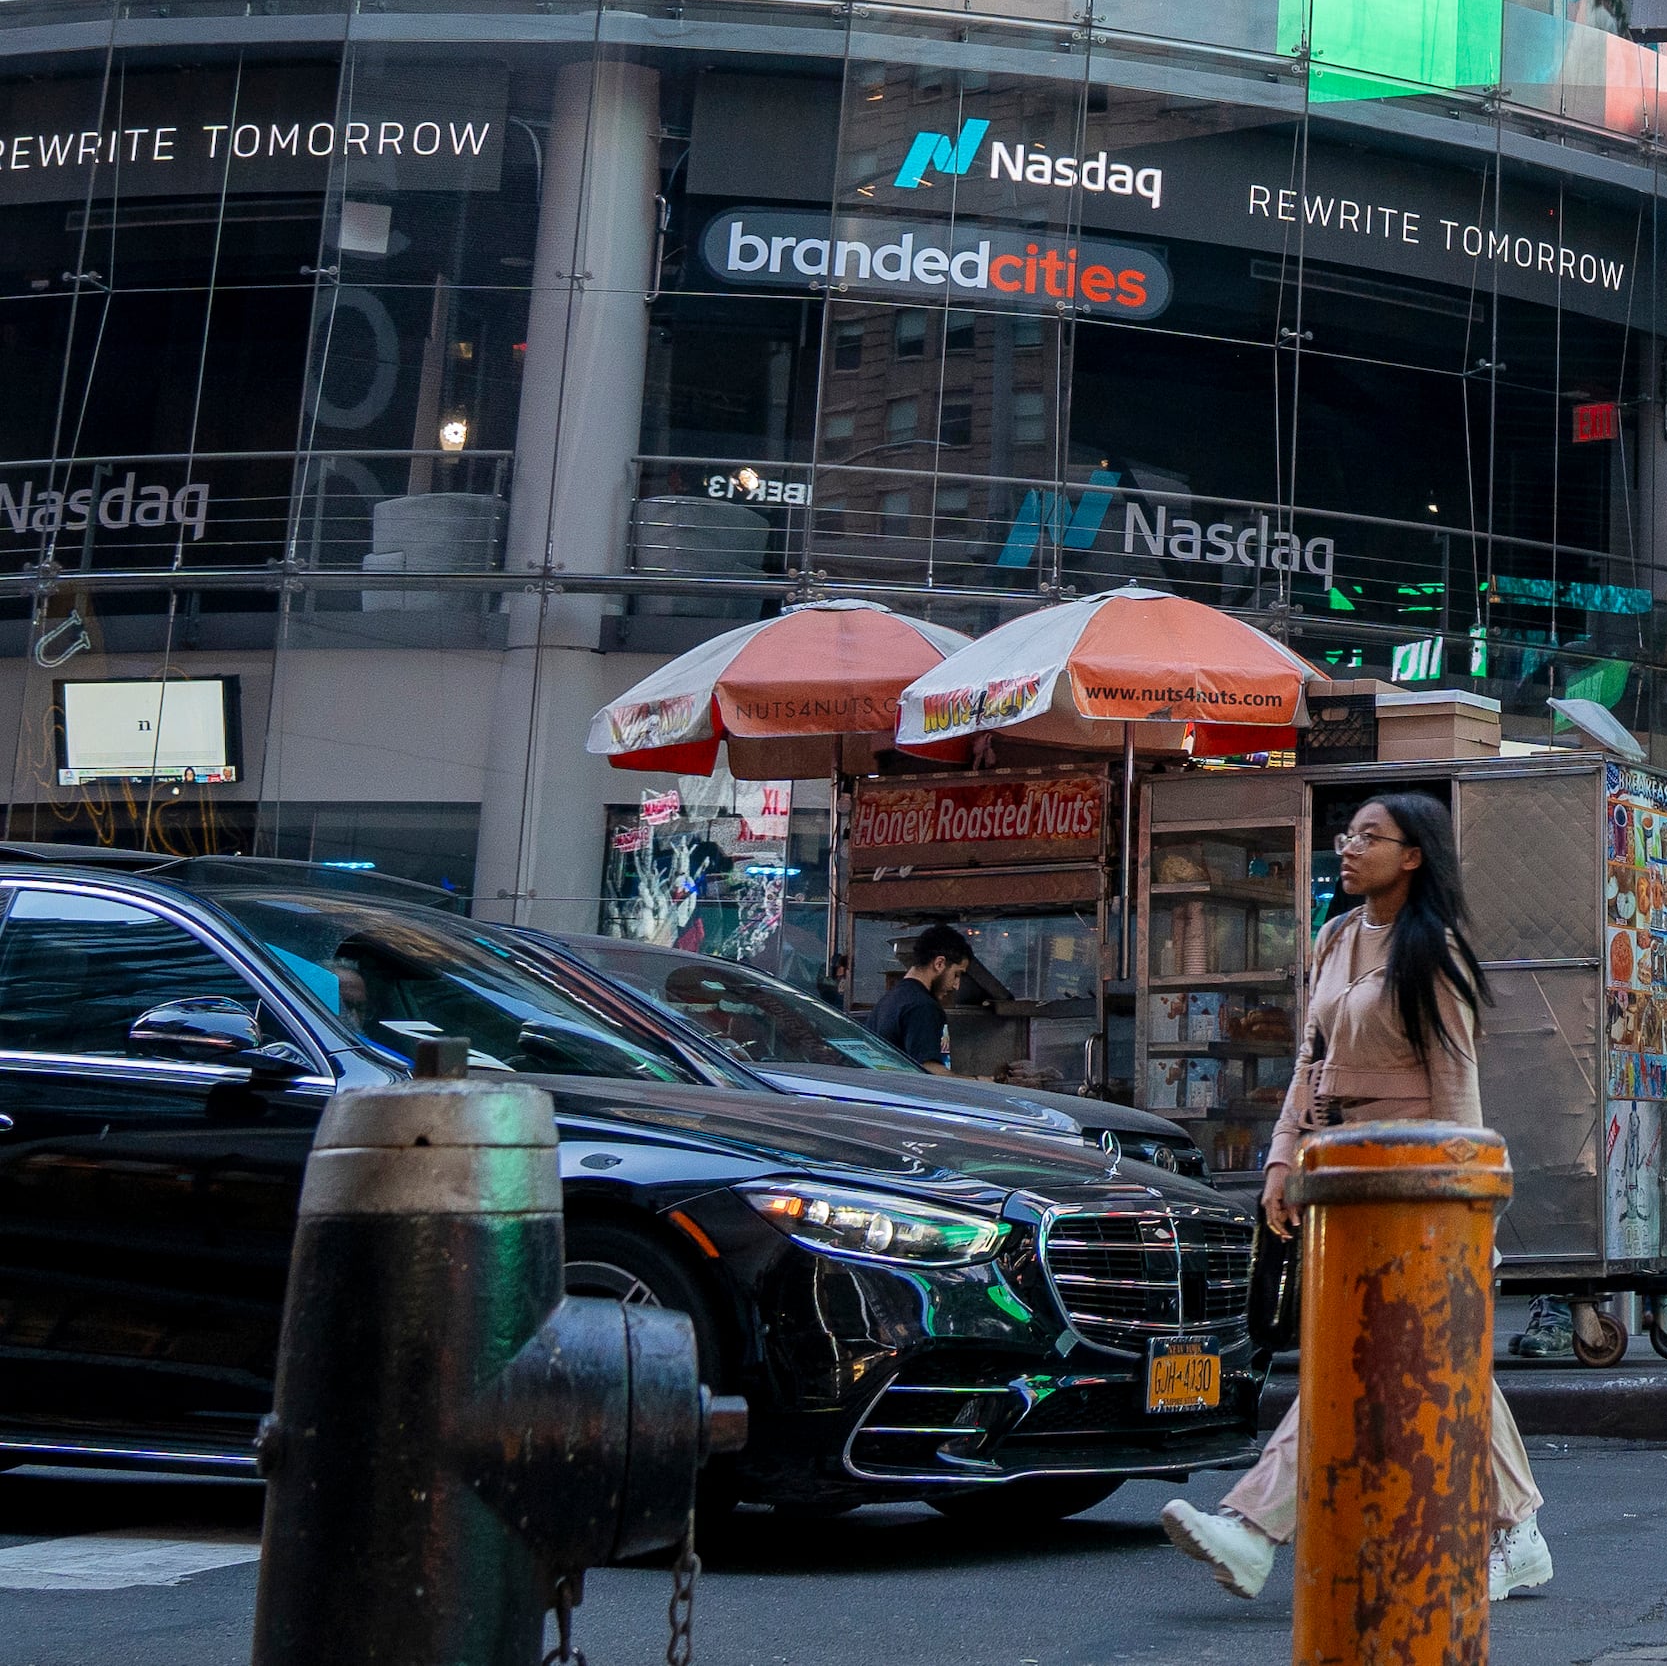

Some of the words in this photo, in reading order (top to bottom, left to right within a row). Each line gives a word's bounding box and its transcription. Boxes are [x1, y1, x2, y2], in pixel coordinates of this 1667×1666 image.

[202, 121, 491, 160] TOMORROW
[990, 140, 1162, 209] Nasdaq
[727, 220, 1148, 308] brandedcities
[1248, 184, 1421, 244] REWRITE
[1440, 219, 1625, 291] TOMORROW
[0, 471, 210, 542] Nasdaq
[1122, 500, 1335, 592] Nasdaq
[736, 696, 897, 722] NUTS4NUTS.C
[1085, 685, 1283, 709] www.nuts4nuts.com
[854, 802, 933, 846] Honey
[936, 790, 1035, 841] Roasted
[1037, 790, 1095, 835] Nuts
